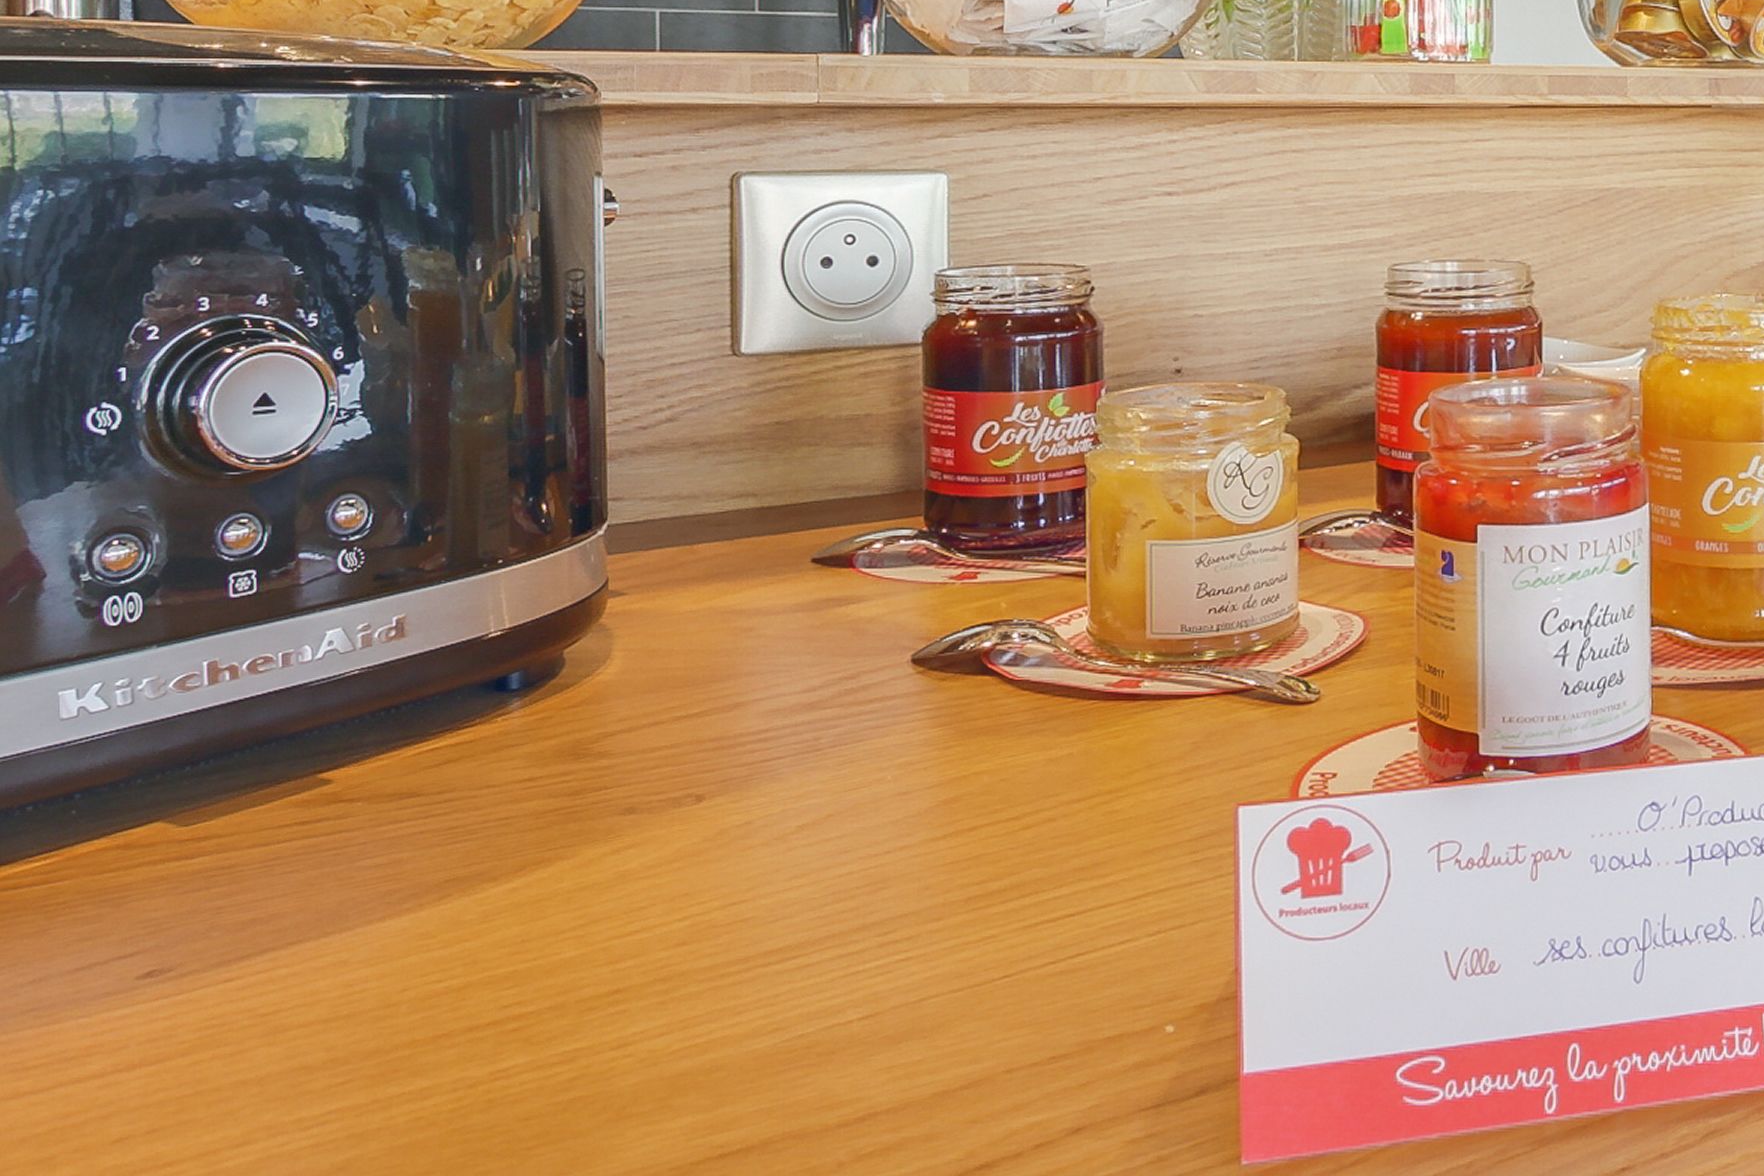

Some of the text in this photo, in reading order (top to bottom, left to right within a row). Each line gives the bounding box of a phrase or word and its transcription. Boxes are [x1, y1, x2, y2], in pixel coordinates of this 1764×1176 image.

[198, 297, 211, 312] 3
[256, 293, 269, 307] 4
[307, 313, 319, 327] 5
[146, 325, 160, 341] 2
[332, 347, 345, 360] 6
[116, 367, 127, 382] 1
[1003, 402, 1042, 426] Les
[972, 412, 1098, 454] Confiottes
[1502, 542, 1569, 565] MON
[1578, 528, 1645, 561] PLAISIR
[1195, 582, 1251, 600] Banane
[1207, 600, 1239, 616] noix
[1242, 593, 1258, 611] de
[1540, 602, 1636, 638] Confiture
[1553, 633, 1630, 672] 4 fruits
[57, 614, 407, 721] KitchenAid
[1560, 669, 1625, 699] rouges
[1427, 840, 1573, 882] Produit par
[1590, 847, 1653, 874] vous
[1278, 901, 1370, 918] Producteurs locaux
[1443, 946, 1502, 981] Ville
[1396, 1055, 1560, 1115] Savourez
[1567, 1042, 1608, 1083] la
